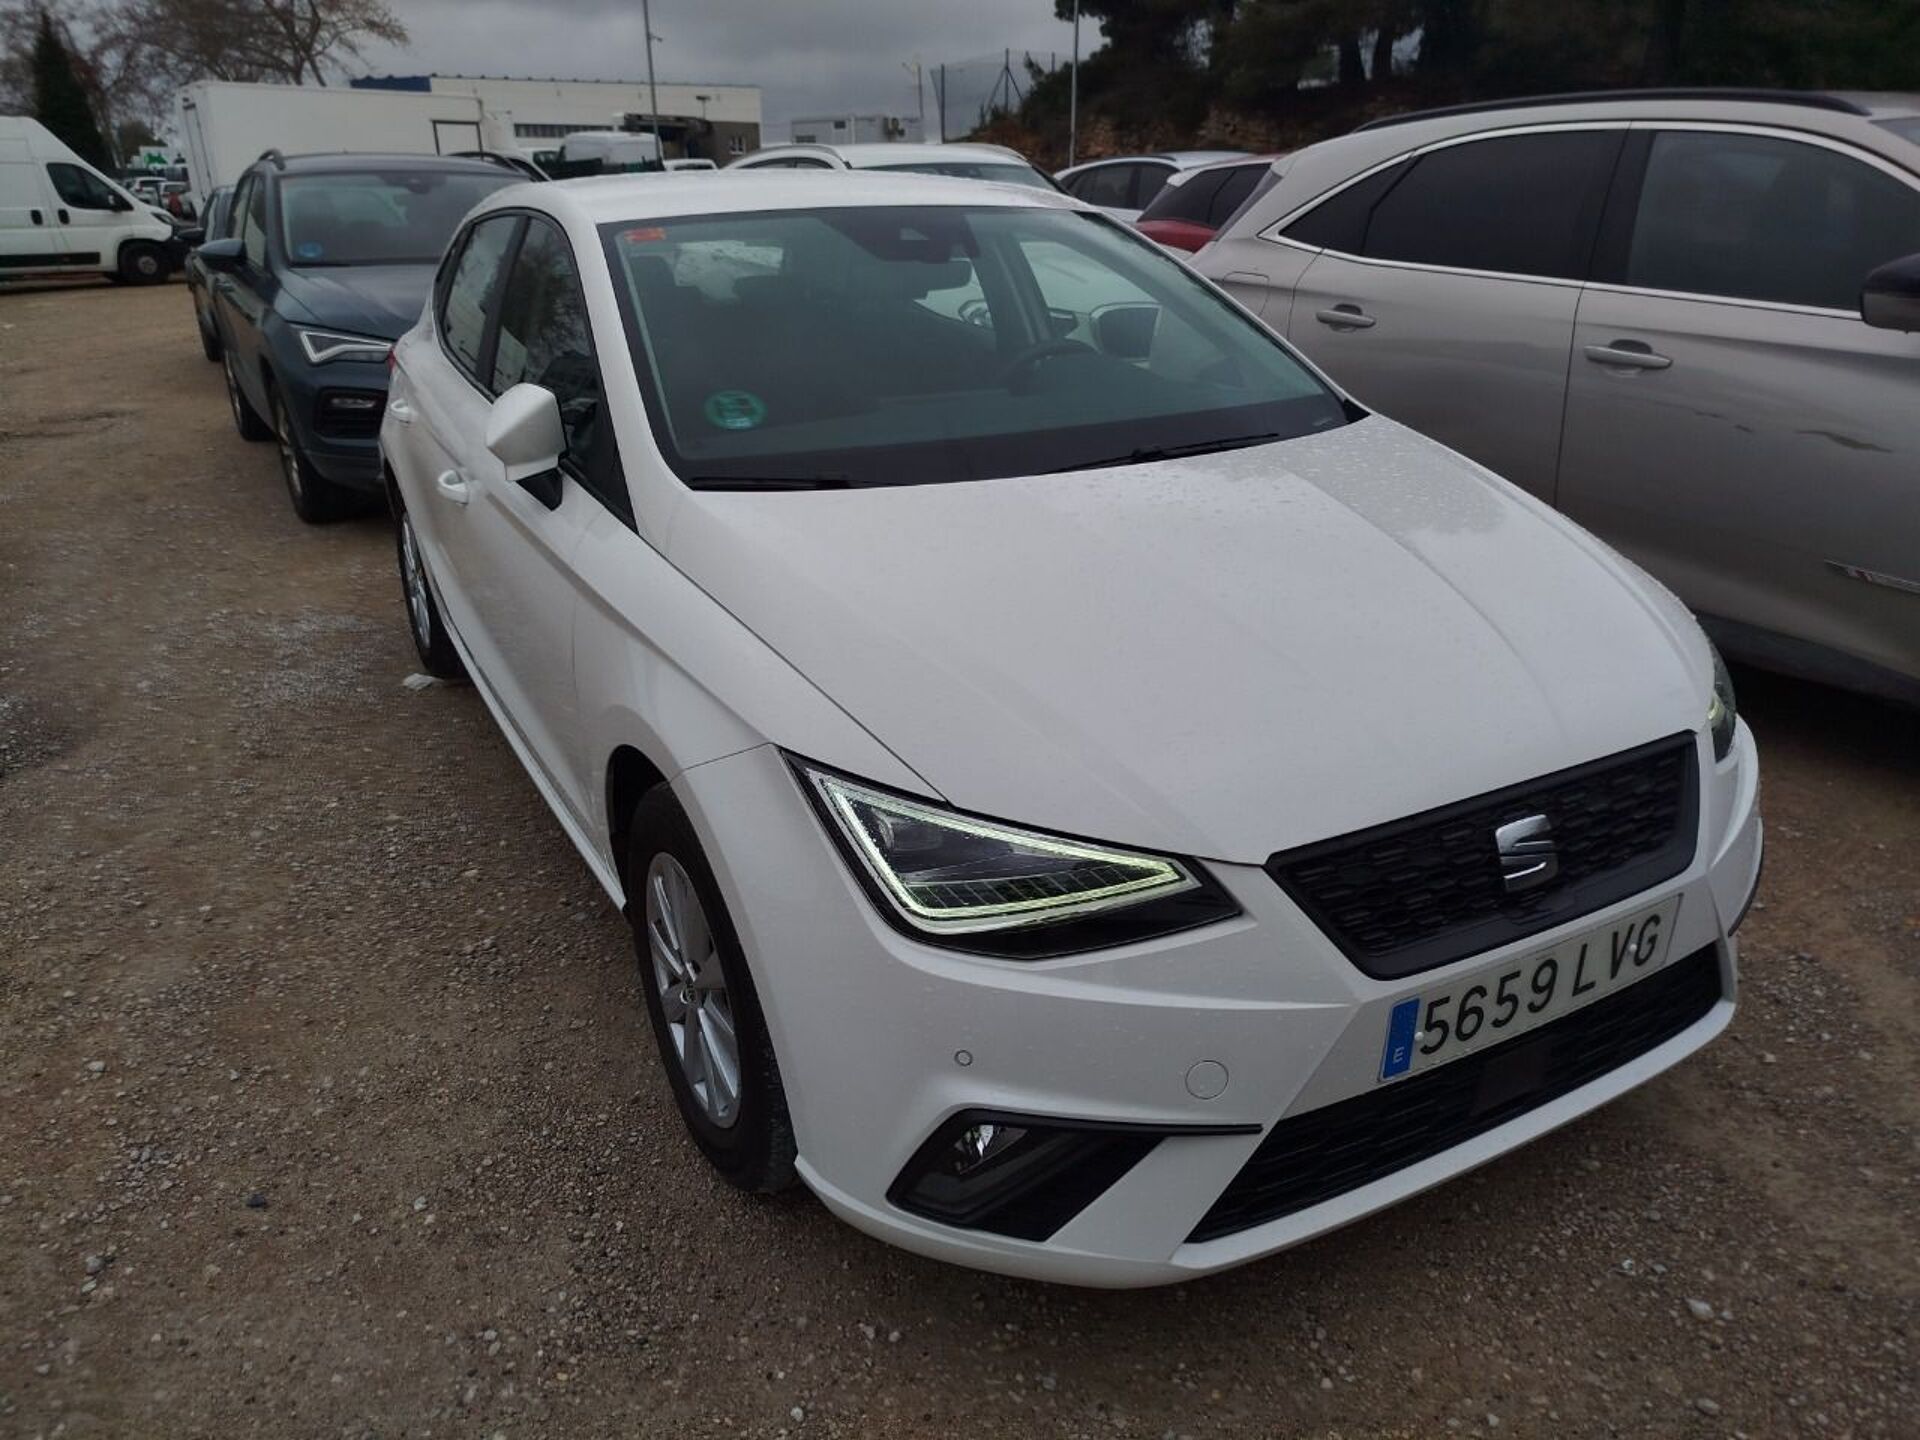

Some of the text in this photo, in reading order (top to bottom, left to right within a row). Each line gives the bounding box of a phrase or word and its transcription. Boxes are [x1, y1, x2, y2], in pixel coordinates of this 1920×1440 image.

[1420, 914, 1660, 1055] 5659 LVG
[1392, 1046, 1405, 1064] E
